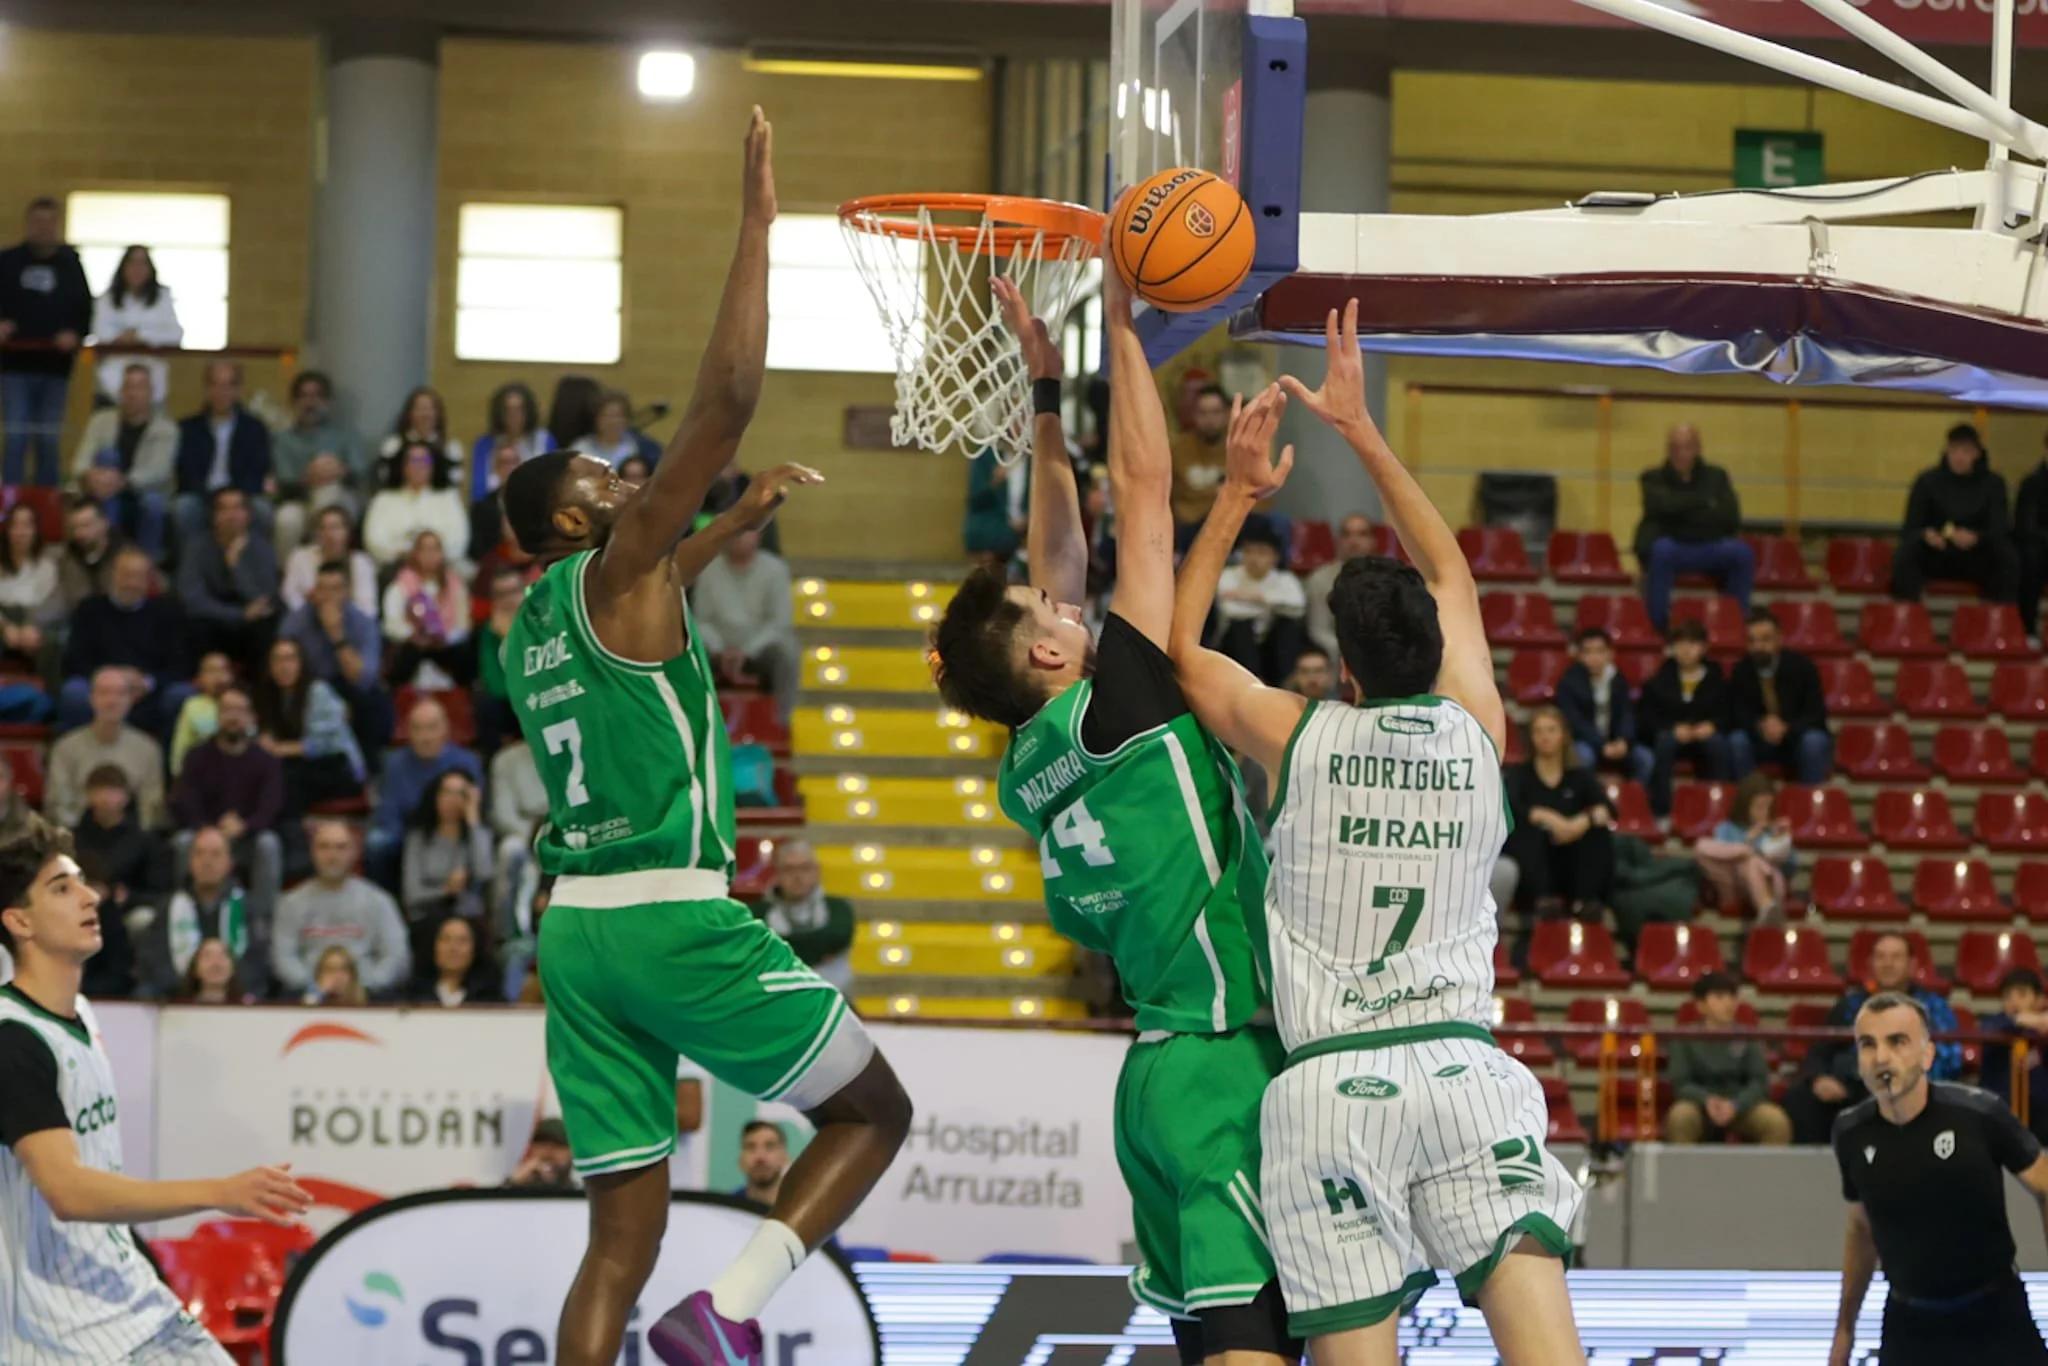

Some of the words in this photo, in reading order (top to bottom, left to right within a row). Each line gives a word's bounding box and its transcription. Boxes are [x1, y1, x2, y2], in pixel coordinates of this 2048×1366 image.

[1763, 140, 1796, 186] E
[1128, 171, 1202, 234] Wilson
[542, 717, 590, 808] 7
[1015, 748, 1087, 814] MAZAIRA
[1385, 819, 1464, 850] RAHI
[1367, 886, 1425, 976] 7
[1348, 1076, 1389, 1097] Ford
[905, 1115, 1080, 1163] Hospital
[902, 1164, 1084, 1209] Arruzafa
